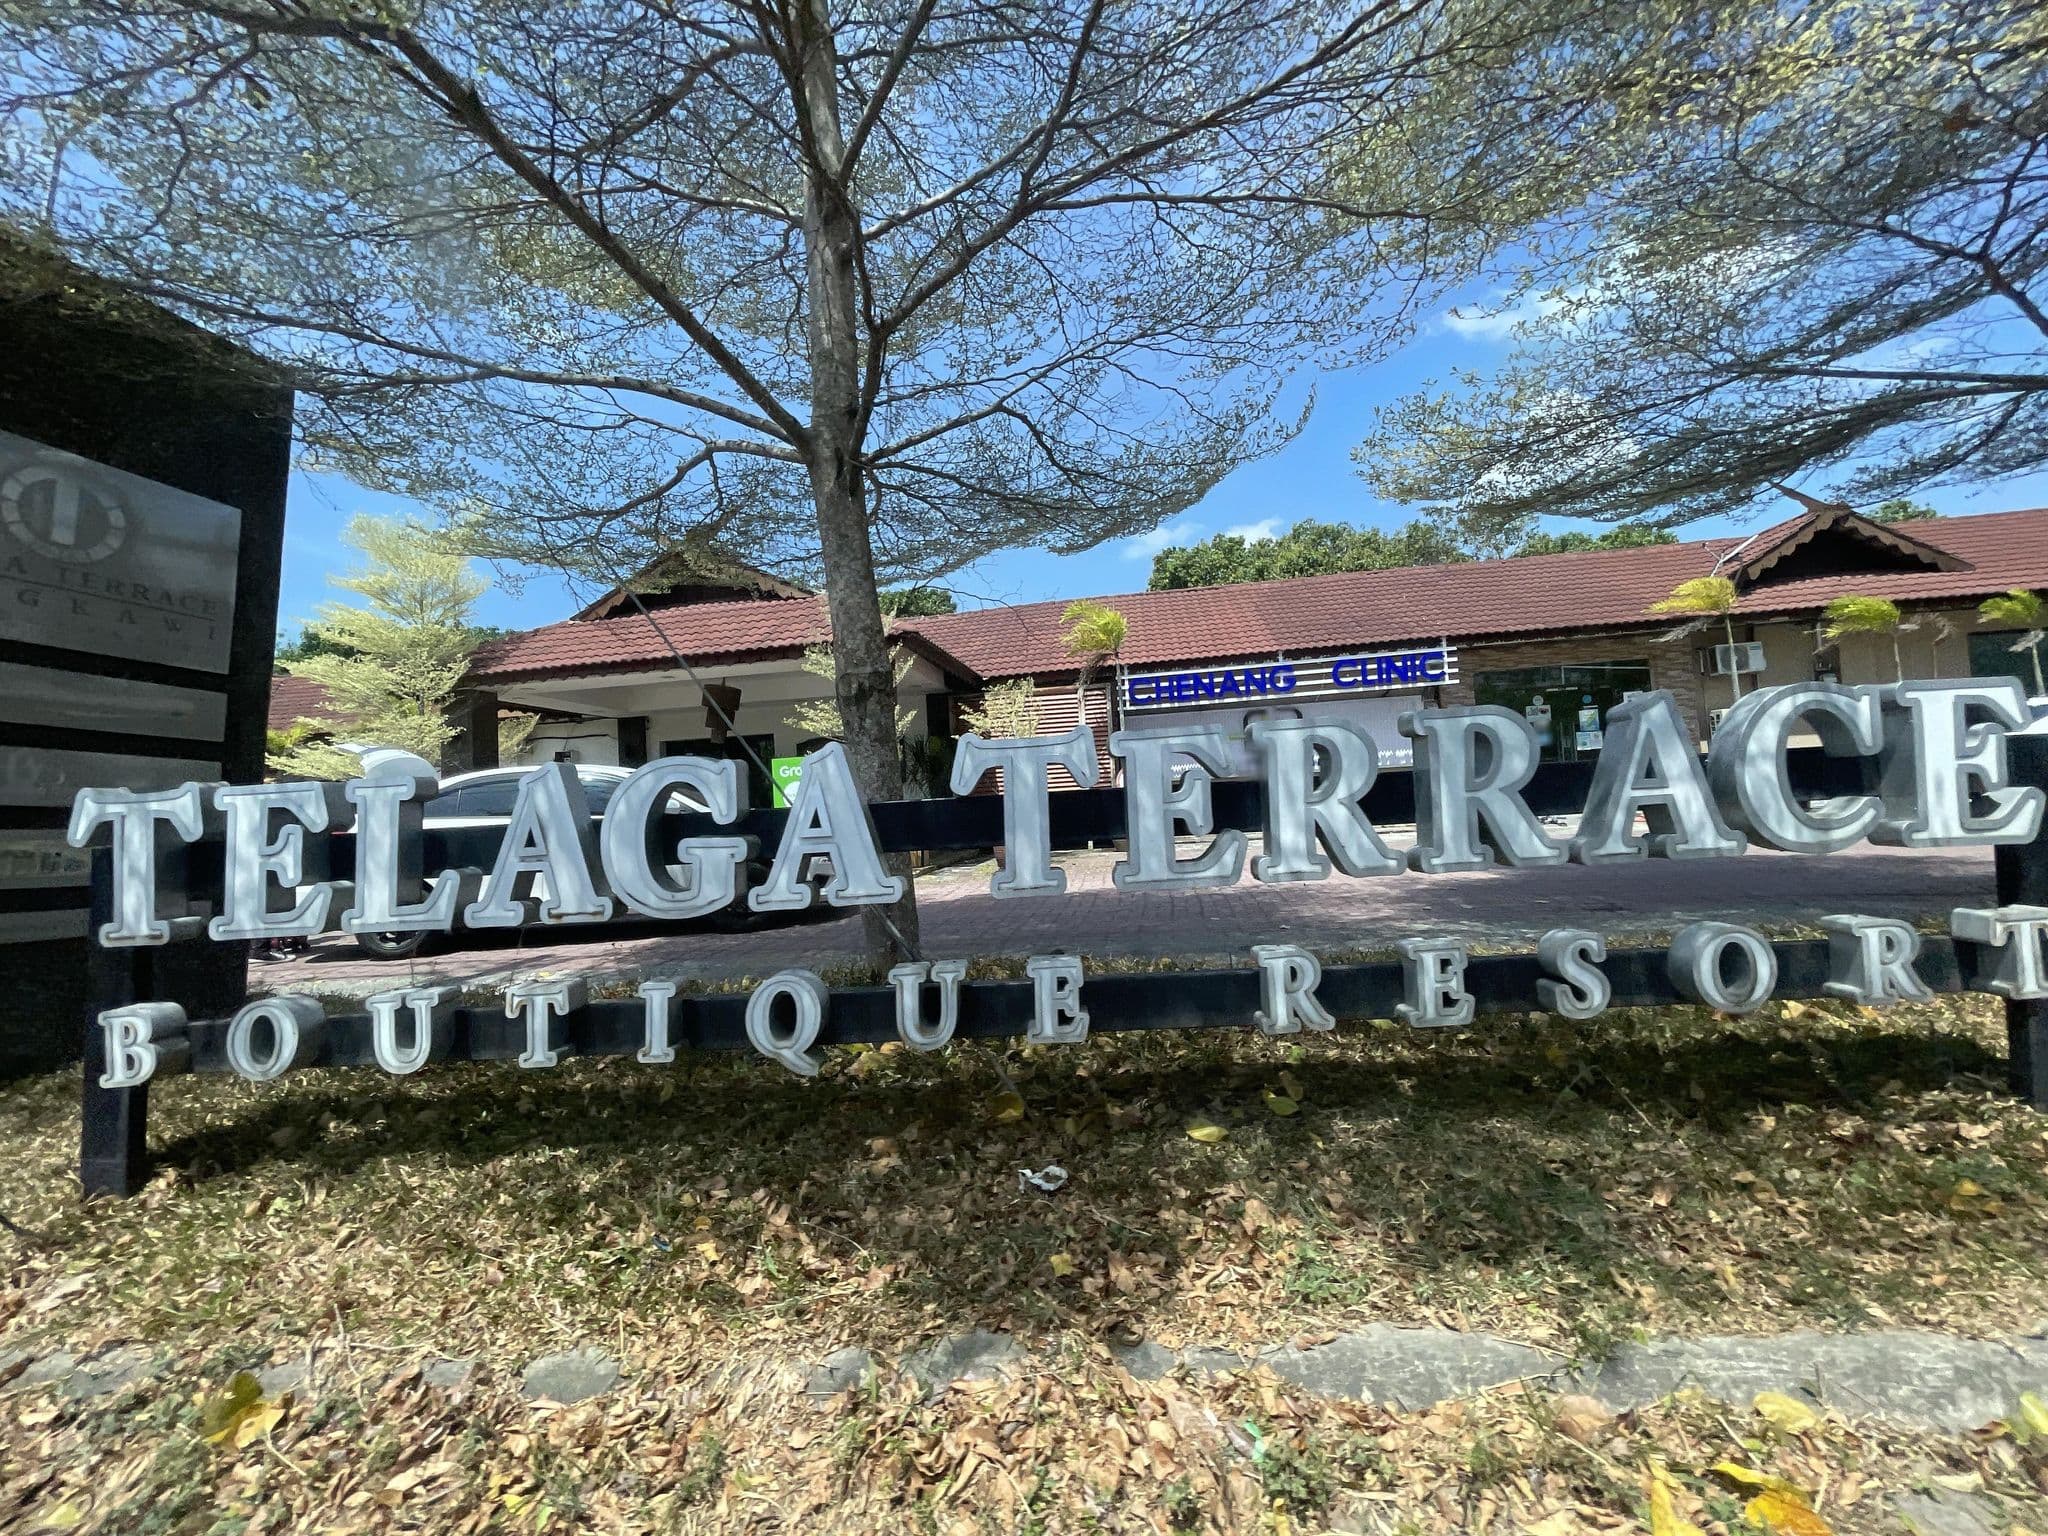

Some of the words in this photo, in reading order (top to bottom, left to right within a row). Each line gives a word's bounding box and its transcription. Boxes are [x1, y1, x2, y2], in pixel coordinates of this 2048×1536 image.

[1128, 665, 1297, 704] CHENANG
[1331, 650, 1447, 688] CLINIC
[67, 740, 906, 947] TELAGA
[950, 676, 2047, 898] TERRACE
[97, 954, 1090, 1089] BOUTIQUE
[1251, 905, 2048, 1034] RESORT
